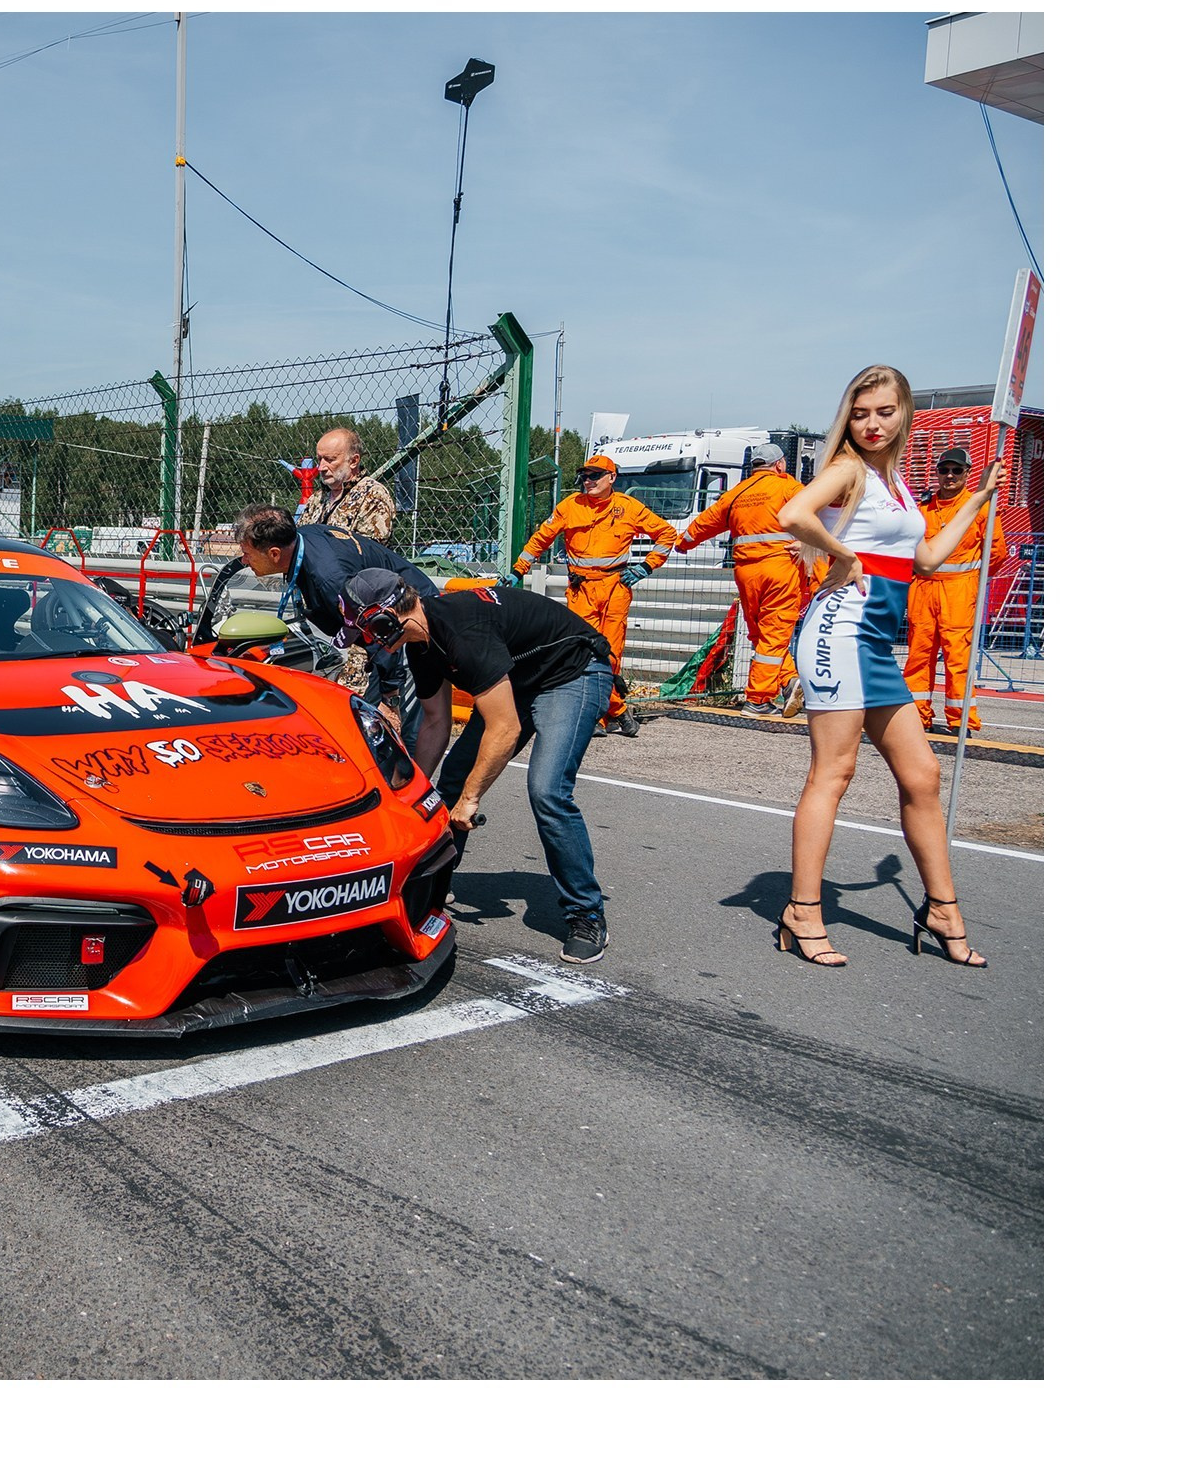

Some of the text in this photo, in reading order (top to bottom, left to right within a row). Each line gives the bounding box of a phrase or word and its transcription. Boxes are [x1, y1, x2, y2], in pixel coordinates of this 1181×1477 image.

[614, 443, 674, 454] ТЕЛЕВИДЕНИЕ
[816, 586, 850, 679] SMP RACIN
[60, 680, 211, 720] HA
[146, 737, 203, 769] SO
[24, 846, 111, 864] YOKOHAMA
[245, 847, 372, 874] MOTORSPORT
[284, 875, 387, 915] YOKOHAMA
[15, 996, 86, 1004] RSCAR
